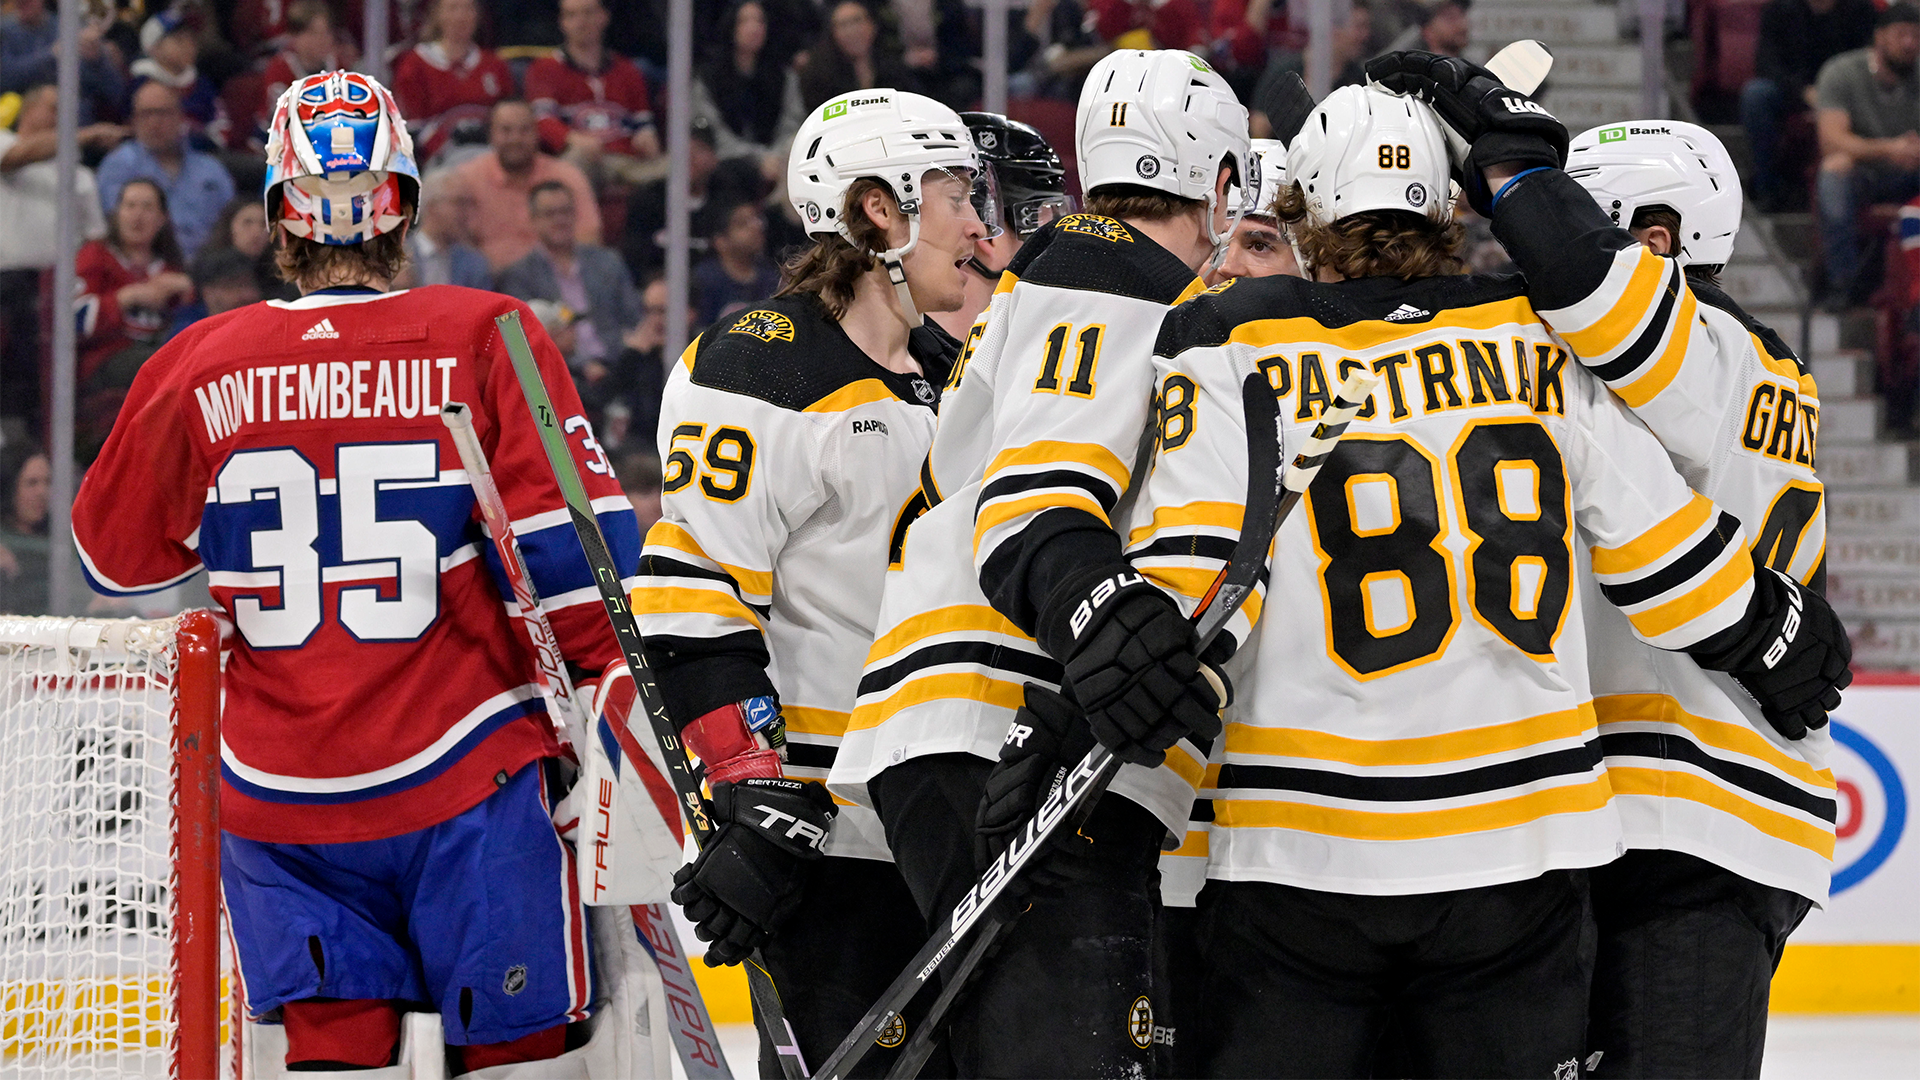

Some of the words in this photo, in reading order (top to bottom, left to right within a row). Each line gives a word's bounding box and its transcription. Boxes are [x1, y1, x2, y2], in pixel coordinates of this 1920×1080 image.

[825, 102, 846, 118] TD
[851, 96, 890, 108] Bank
[1110, 102, 1128, 127] 11
[1600, 128, 1624, 142] TD
[1630, 126, 1671, 135] Bank
[1378, 144, 1411, 170] 88
[301, 330, 340, 341] adidas
[1384, 308, 1430, 321] adidas
[1031, 322, 1106, 400] 11
[1256, 336, 1569, 424] PASTRNAK
[194, 357, 457, 444] MONTEMBEAULT
[564, 414, 617, 479] 3
[663, 421, 757, 505] 59
[215, 439, 440, 651] 35
[1303, 416, 1573, 683] 88
[1069, 572, 1144, 640] BAU
[1762, 567, 1804, 670] BAU
[598, 567, 690, 775] CATALYST
[747, 779, 802, 790] BERTUZZI
[594, 777, 612, 903] TRUE
[951, 751, 1094, 934] BAUER
[922, 938, 955, 977] BAUER
